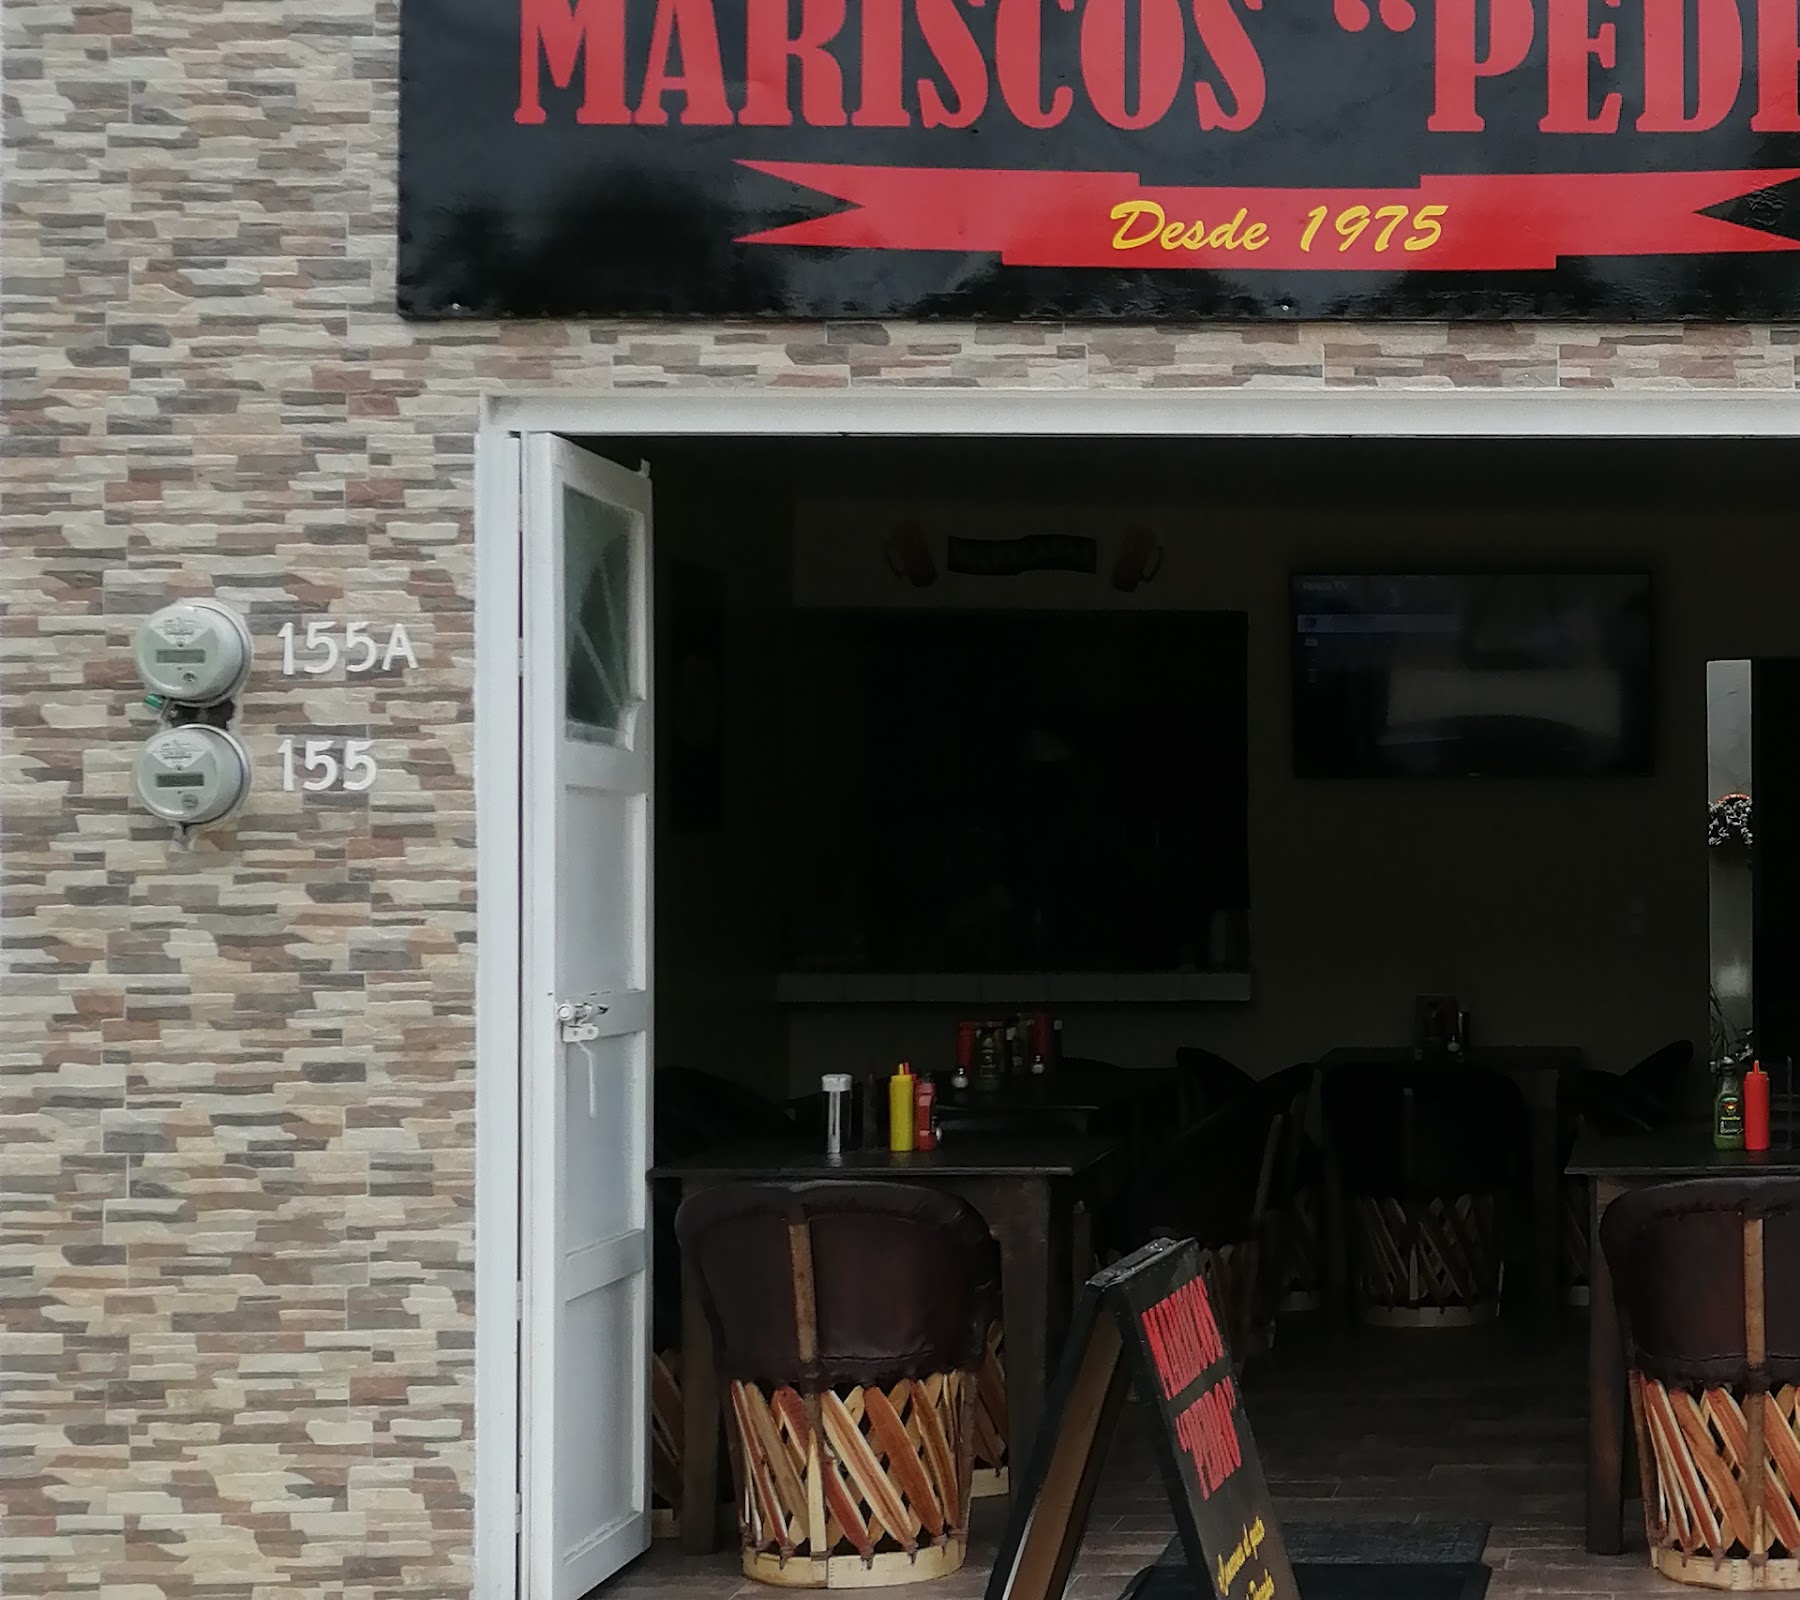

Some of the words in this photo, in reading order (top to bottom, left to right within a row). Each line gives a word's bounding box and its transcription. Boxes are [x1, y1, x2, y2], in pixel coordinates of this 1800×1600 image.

[1110, 199, 1270, 252] Desde
[1300, 204, 1449, 252] 1975
[276, 621, 420, 676] 155A
[276, 738, 379, 792] 155
[1141, 1275, 1224, 1401] MARISCOS
